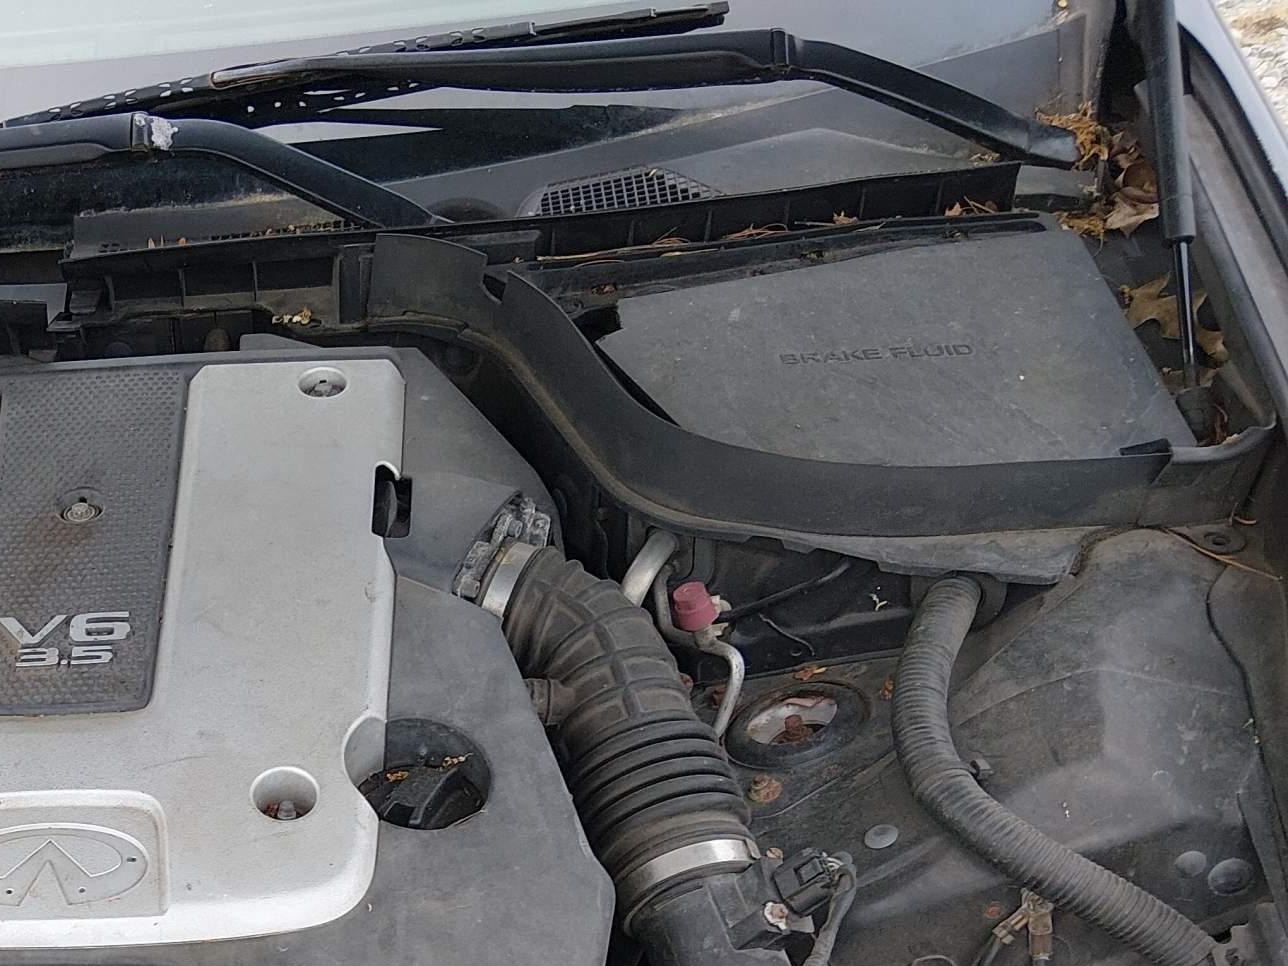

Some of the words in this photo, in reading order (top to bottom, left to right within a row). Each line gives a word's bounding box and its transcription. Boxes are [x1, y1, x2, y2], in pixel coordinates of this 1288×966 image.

[779, 347, 882, 365] BRAKE
[889, 344, 973, 358] FLUID
[16, 645, 113, 667] 3.5
